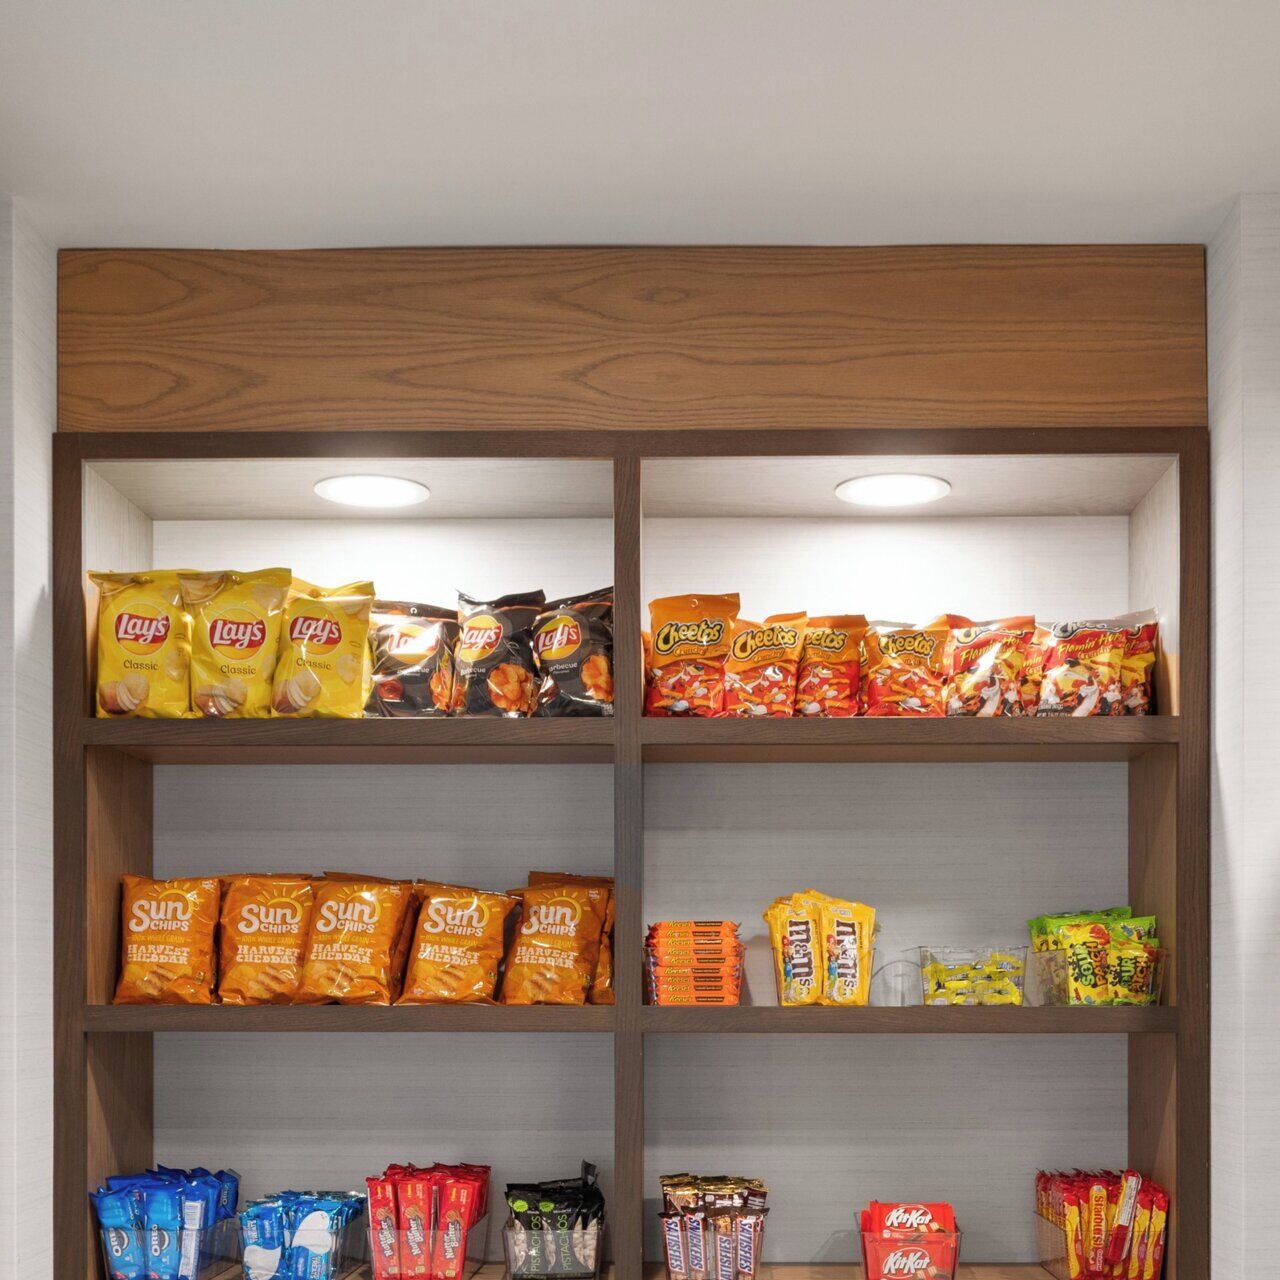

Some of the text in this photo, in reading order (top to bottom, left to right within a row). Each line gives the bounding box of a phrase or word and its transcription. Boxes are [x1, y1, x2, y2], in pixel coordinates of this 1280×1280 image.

[117, 613, 168, 645] Lay's
[212, 618, 265, 648] Lay's
[291, 614, 340, 645] Lay's
[538, 622, 578, 652] Lay's
[656, 620, 725, 655] Cheetos
[731, 625, 800, 662] Cheetos
[804, 627, 849, 652] eetos
[123, 659, 159, 671] Classic
[220, 664, 257, 675] Classic
[549, 661, 578, 672] arbecue
[129, 899, 193, 933] Sun
[149, 919, 190, 932] CHIPS
[238, 903, 295, 934] Sun
[259, 922, 299, 934] CHIPS
[316, 900, 374, 933] Sun
[336, 921, 375, 934] CHIPS
[423, 899, 480, 934] Sun
[444, 925, 483, 937] CHIPS
[521, 904, 574, 936] Sun
[538, 924, 577, 937] CHIPS
[126, 953, 189, 965] CHEDDAR
[127, 944, 191, 956] HARVEST
[236, 953, 298, 965] CHEDDAR
[237, 944, 300, 956] HARVEST
[310, 951, 371, 965] CHEDDAR
[312, 943, 374, 957] HARVEST
[1074, 942, 1096, 986] SOUR
[1119, 957, 1136, 989] OUR
[109, 1226, 122, 1257] OREO
[150, 1224, 163, 1257] OREO
[557, 1213, 568, 1271] PISTACHIOS
